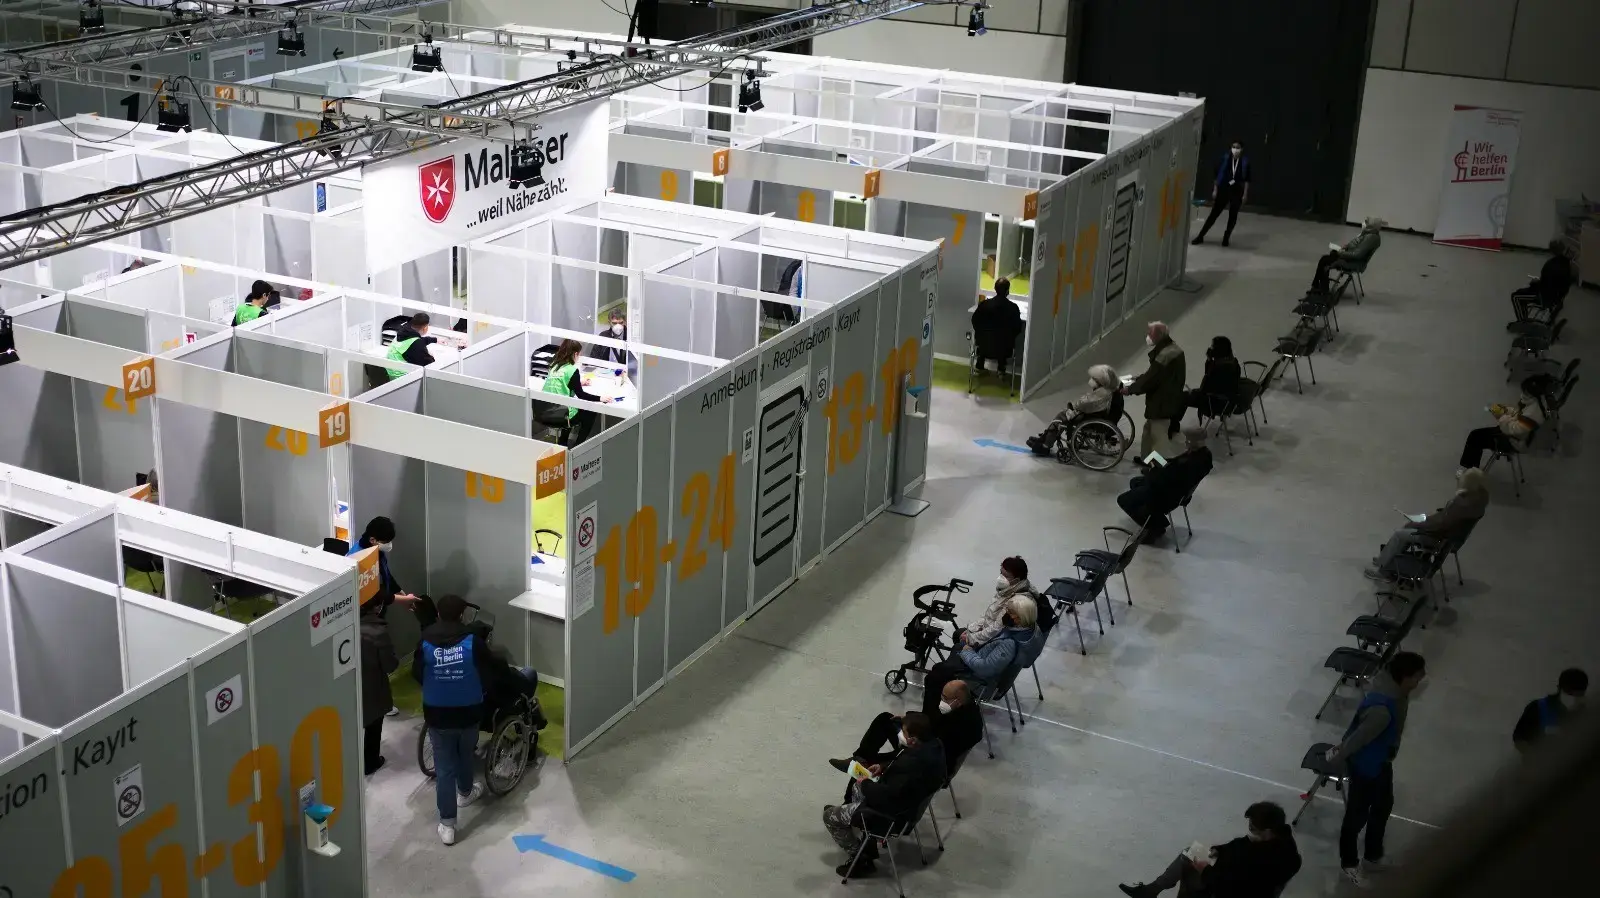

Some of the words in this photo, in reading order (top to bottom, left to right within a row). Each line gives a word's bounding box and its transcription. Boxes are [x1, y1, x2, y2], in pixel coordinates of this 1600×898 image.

[1472, 153, 1508, 165] helfen
[1474, 141, 1494, 154] Wir
[718, 155, 725, 171] 8
[1471, 164, 1506, 177] Berlin
[660, 170, 678, 201] 9
[870, 176, 876, 193] 7
[506, 190, 534, 215] Nähe
[951, 213, 968, 246] 7
[928, 292, 934, 309] B
[772, 326, 831, 371] Registration
[127, 365, 152, 393] 20
[324, 411, 346, 439] 19
[538, 463, 564, 485] 19-24
[594, 451, 737, 636] 19-24
[322, 595, 353, 619] Malteser
[338, 638, 351, 665] C
[443, 653, 463, 663] Berlin
